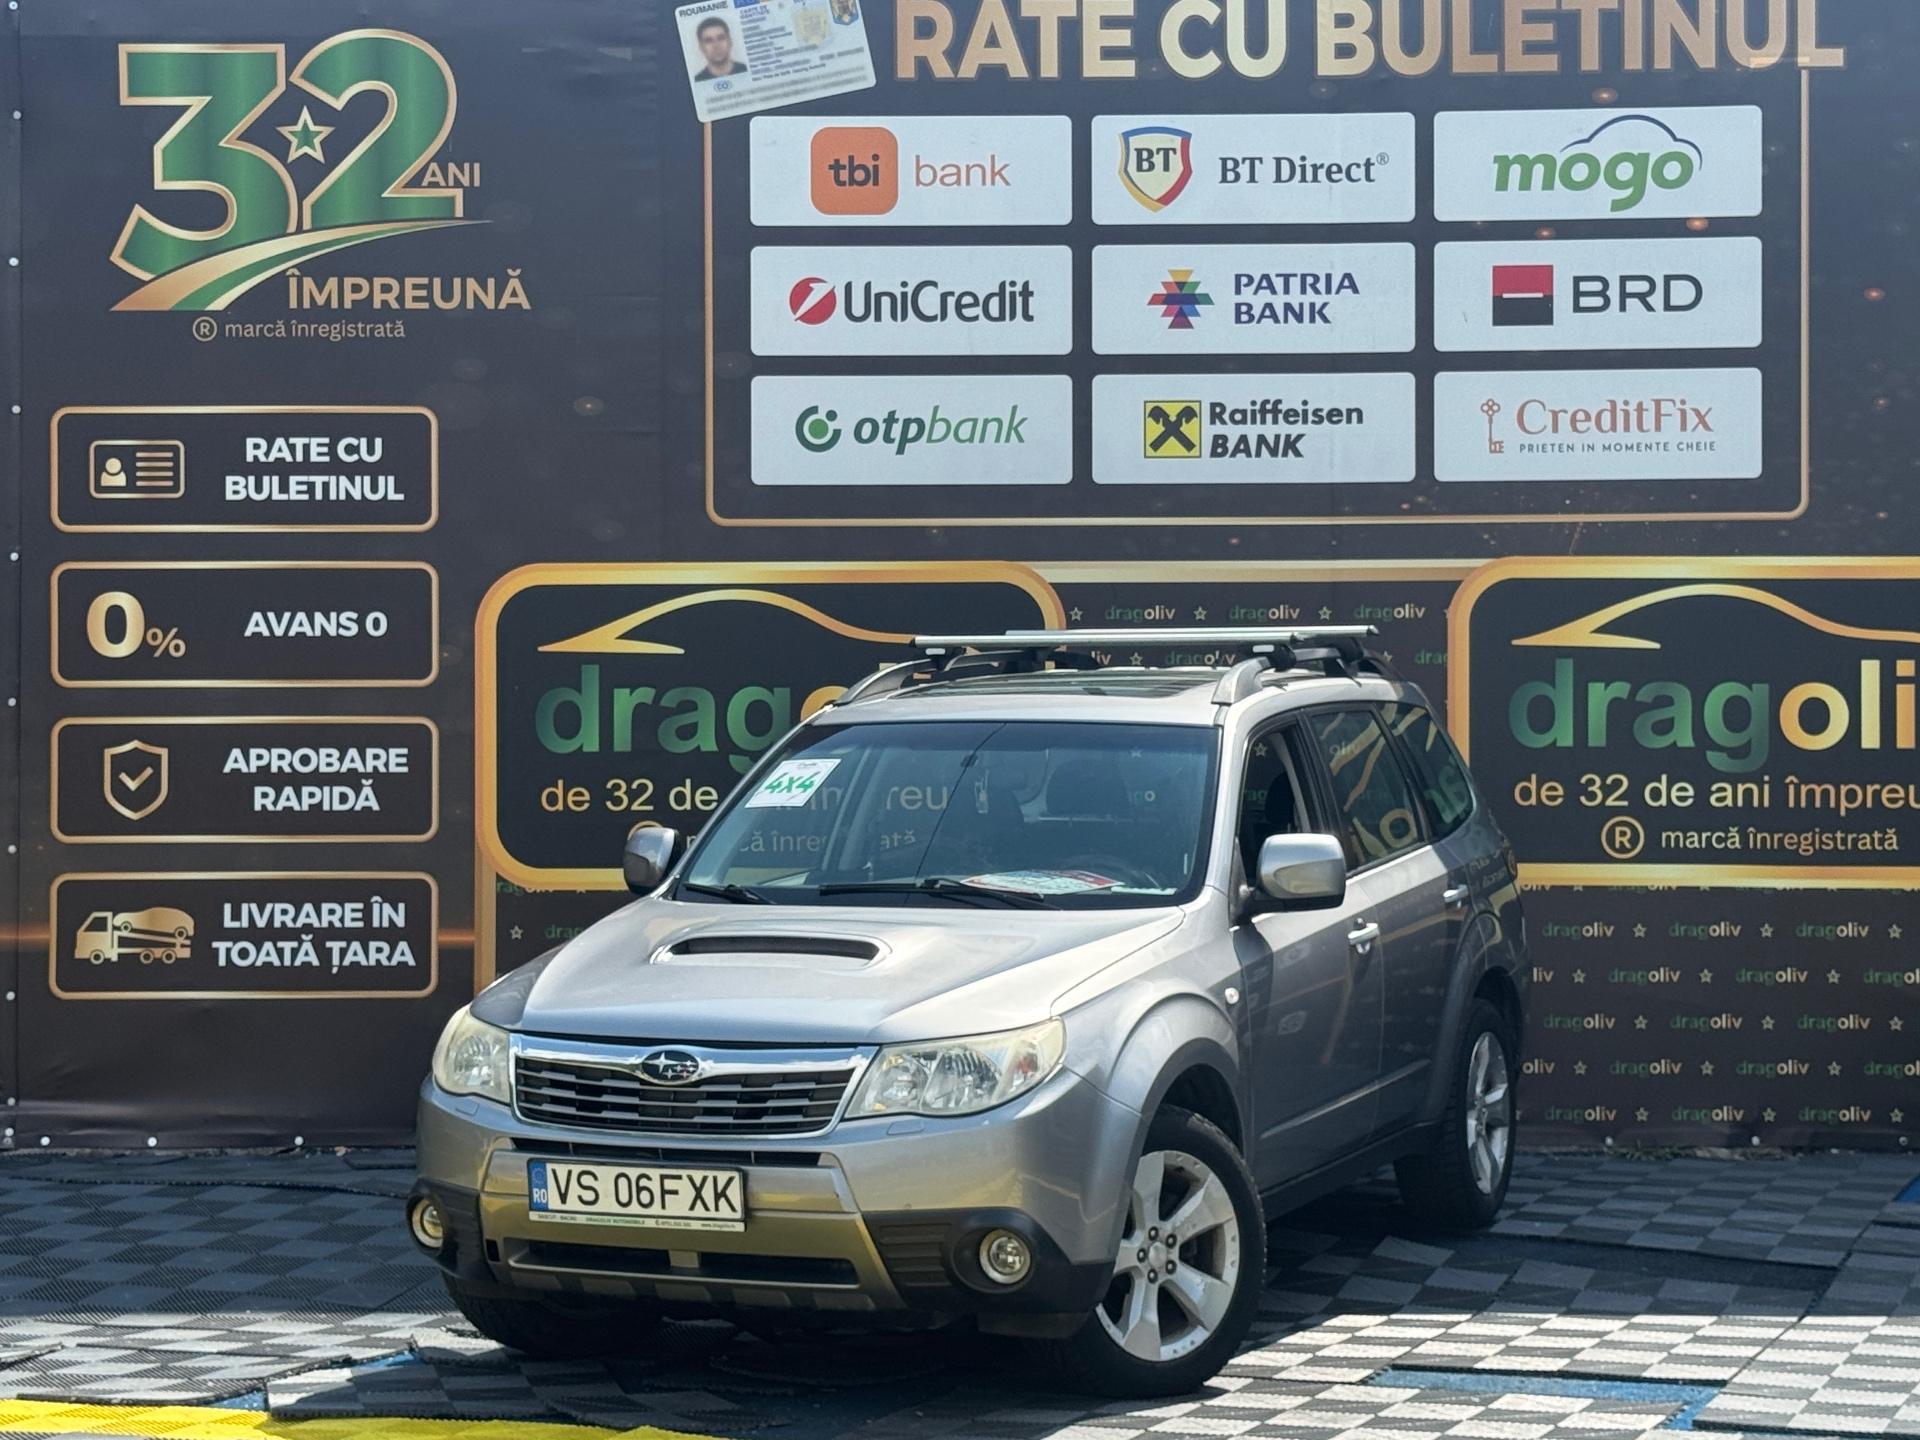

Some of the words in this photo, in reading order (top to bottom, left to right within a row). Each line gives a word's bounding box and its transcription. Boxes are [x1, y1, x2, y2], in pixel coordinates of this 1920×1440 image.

[896, 0, 1138, 79] RATE
[1159, 0, 1288, 79] CU
[1316, 0, 1846, 77] BULETINUL
[110, 28, 463, 281] 32
[1134, 147, 1177, 172] BT
[421, 162, 481, 187] ANI
[828, 153, 880, 187] tbi
[914, 154, 1011, 187] bank
[1218, 157, 1264, 184] BT
[1493, 150, 1694, 213] mogo
[287, 268, 532, 311] ÎMPREUNĂ
[1233, 272, 1360, 296] PATRIA
[1572, 274, 1704, 313] BRD
[844, 280, 1034, 323] UniCredit
[1233, 301, 1332, 325] BANK
[225, 319, 286, 338] marcă
[290, 319, 406, 344] înregistrată
[1209, 399, 1364, 426] Raiffeisen
[1516, 398, 1714, 435] CreditFix
[853, 404, 1028, 456] otpbank
[245, 436, 330, 462] RATE
[336, 436, 383, 463] CU
[1209, 433, 1306, 458] BANK
[1519, 442, 1576, 454] PRIETEN
[1581, 441, 1595, 453] IN
[1602, 441, 1670, 452] MOMENTE
[1676, 440, 1716, 452] CHEIE
[224, 475, 405, 502] BULETINUL
[86, 590, 187, 659] 0%
[243, 611, 360, 638] AVANS
[365, 611, 388, 637] 0
[1104, 604, 1176, 623] dragoliv
[1228, 604, 1300, 623] dragoliv
[1353, 603, 1426, 622] dragoliv
[535, 664, 848, 773] drag
[222, 747, 409, 774] APROBARE
[253, 779, 381, 812] RAPIDĂ
[541, 778, 591, 812] de
[605, 778, 654, 812] 32
[669, 778, 719, 812] de
[1513, 773, 1565, 808] de
[1579, 773, 1630, 808] 32
[1644, 773, 1695, 808] de
[1709, 775, 1771, 808] ani
[1661, 826, 1741, 850] marcă
[1747, 827, 1899, 856] înregistrată
[222, 903, 364, 928] LIVRARE
[370, 895, 406, 928] ÎN
[1542, 921, 1615, 940] dragoliv
[1668, 921, 1742, 940] dragoliv
[1796, 921, 1870, 940] dragoliv
[211, 934, 320, 967] TOATĂ
[325, 940, 416, 974] ȚARA
[1608, 967, 1681, 986] dragoliv
[1735, 967, 1808, 986] dragoliv
[1543, 1012, 1616, 1032] dragoliv
[1669, 1012, 1743, 1032] dragoliv
[1797, 1013, 1871, 1033] dragoliv
[1609, 1058, 1682, 1078] dragoliv
[1736, 1058, 1810, 1078] dragoliv
[1544, 1104, 1617, 1124] dragoliv
[1671, 1105, 1745, 1124] dragoliv
[1798, 1105, 1872, 1125] dragoliv
[533, 1187, 547, 1203] RO
[551, 1168, 600, 1207] VS
